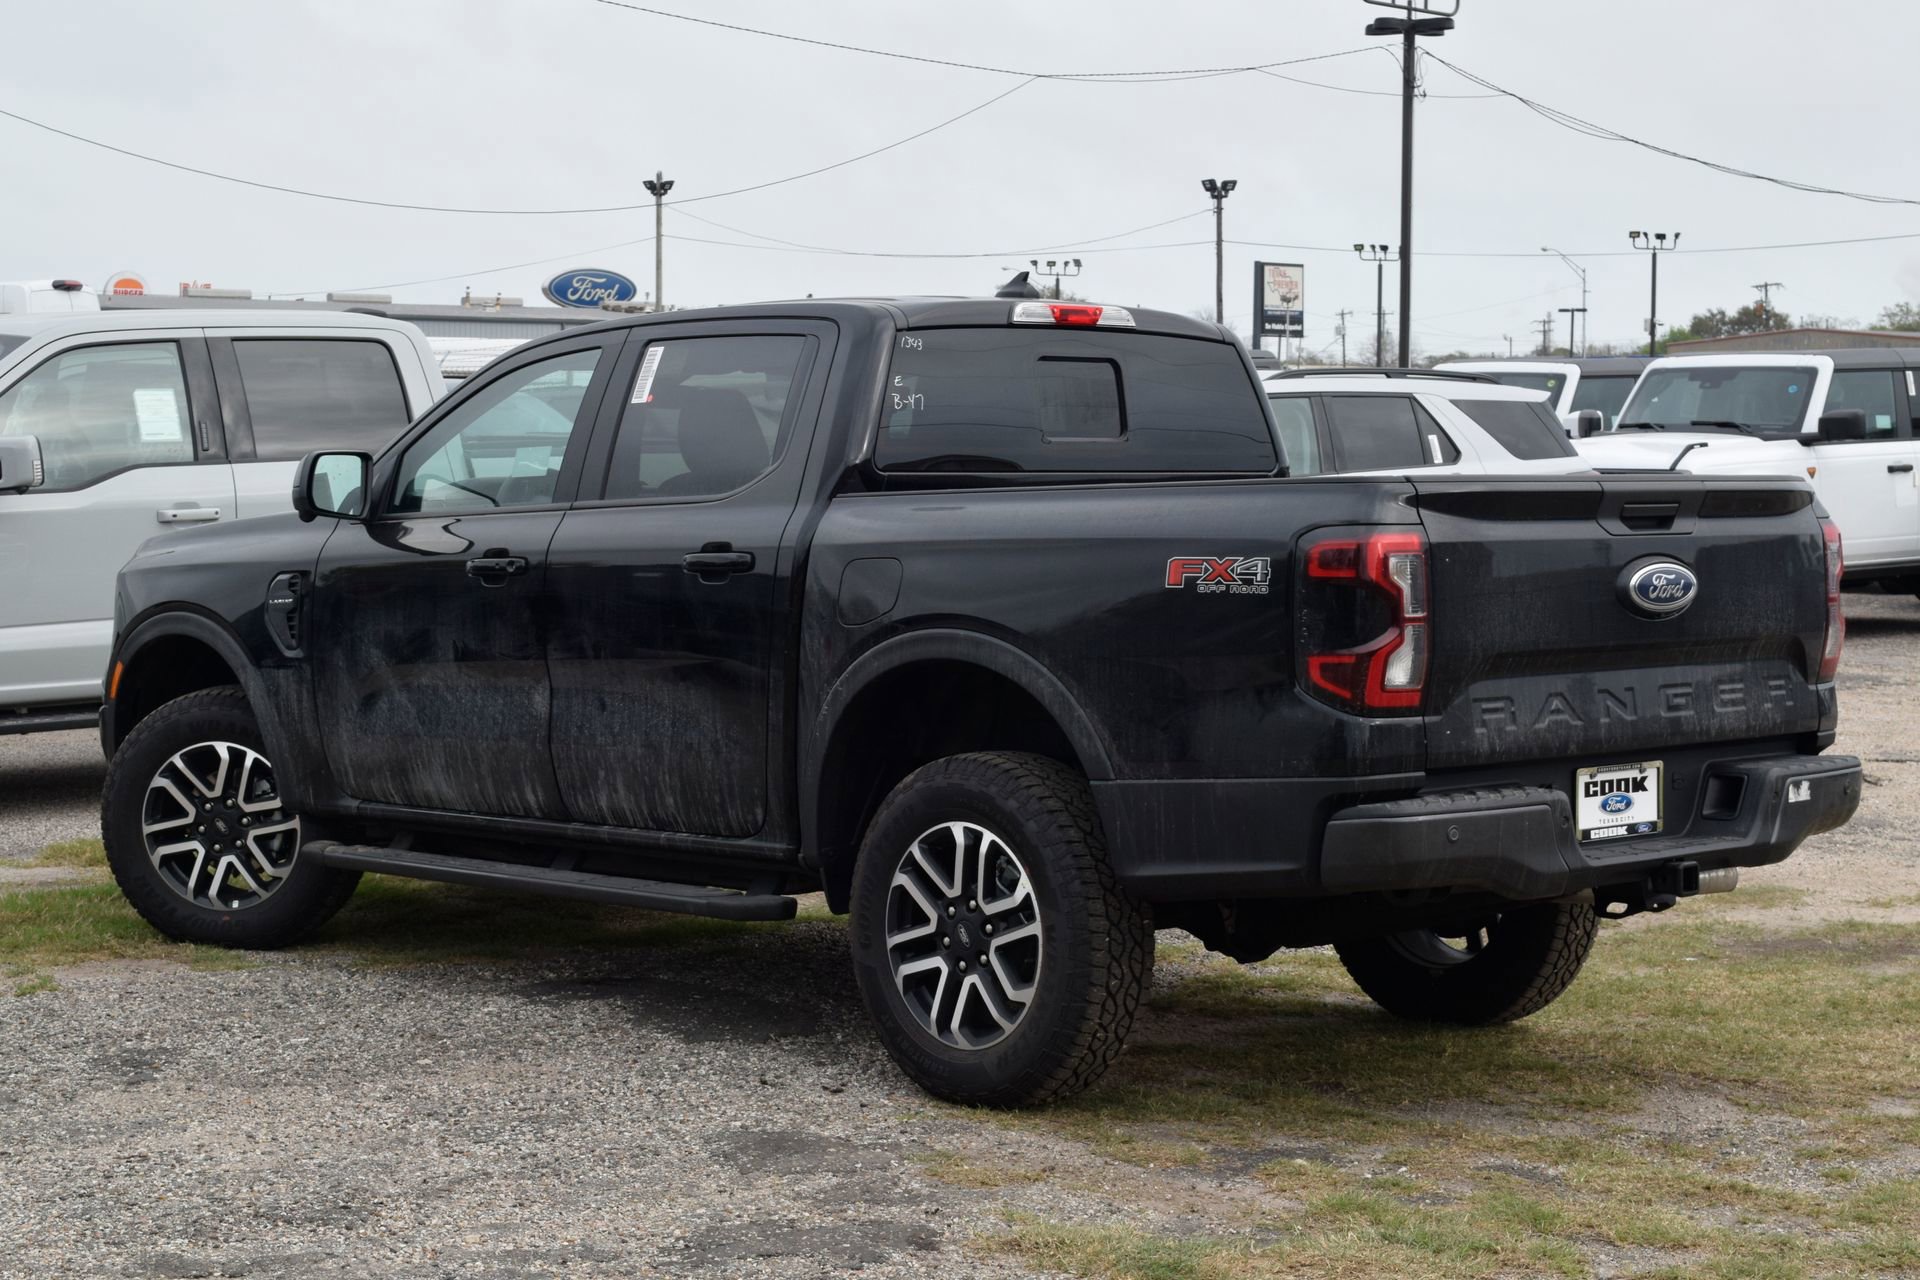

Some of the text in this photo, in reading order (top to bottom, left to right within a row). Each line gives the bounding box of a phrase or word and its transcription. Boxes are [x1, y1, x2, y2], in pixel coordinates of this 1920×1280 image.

[567, 275, 620, 302] Ford
[901, 336, 923, 351] 1343
[895, 375, 903, 387] E
[1165, 556, 1271, 588] FX4
[1197, 584, 1269, 595] OFF ROAD
[1648, 572, 1686, 600] Ford
[1471, 678, 1795, 733] RANGER
[1584, 775, 1648, 798] COOK
[1606, 797, 1627, 812] Ford
[1590, 825, 1629, 839] COOK
